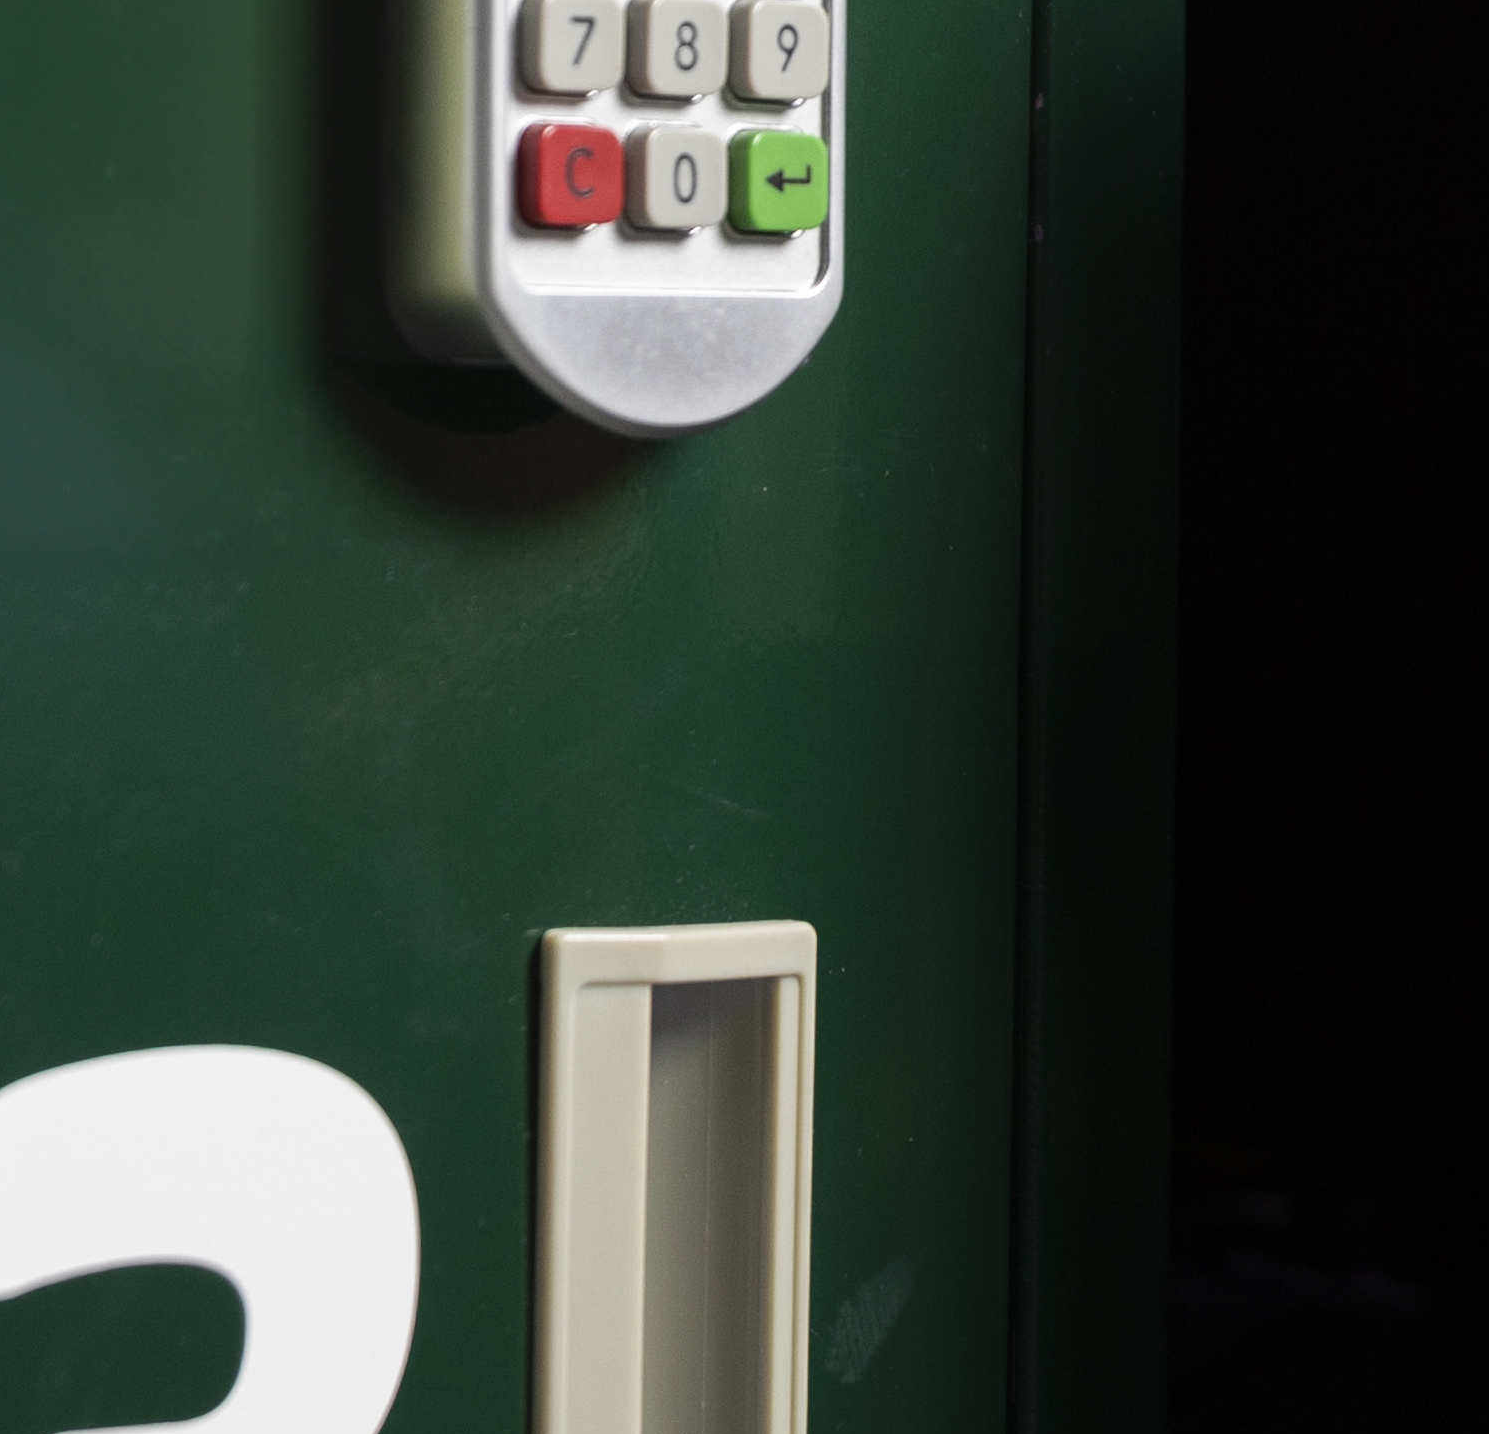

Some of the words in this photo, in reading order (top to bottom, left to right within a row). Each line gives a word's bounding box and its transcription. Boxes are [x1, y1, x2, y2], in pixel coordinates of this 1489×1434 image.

[569, 14, 598, 67] 7
[673, 19, 700, 74] 8
[775, 22, 801, 73] 9
[563, 144, 596, 200] C
[672, 151, 699, 206] 0
